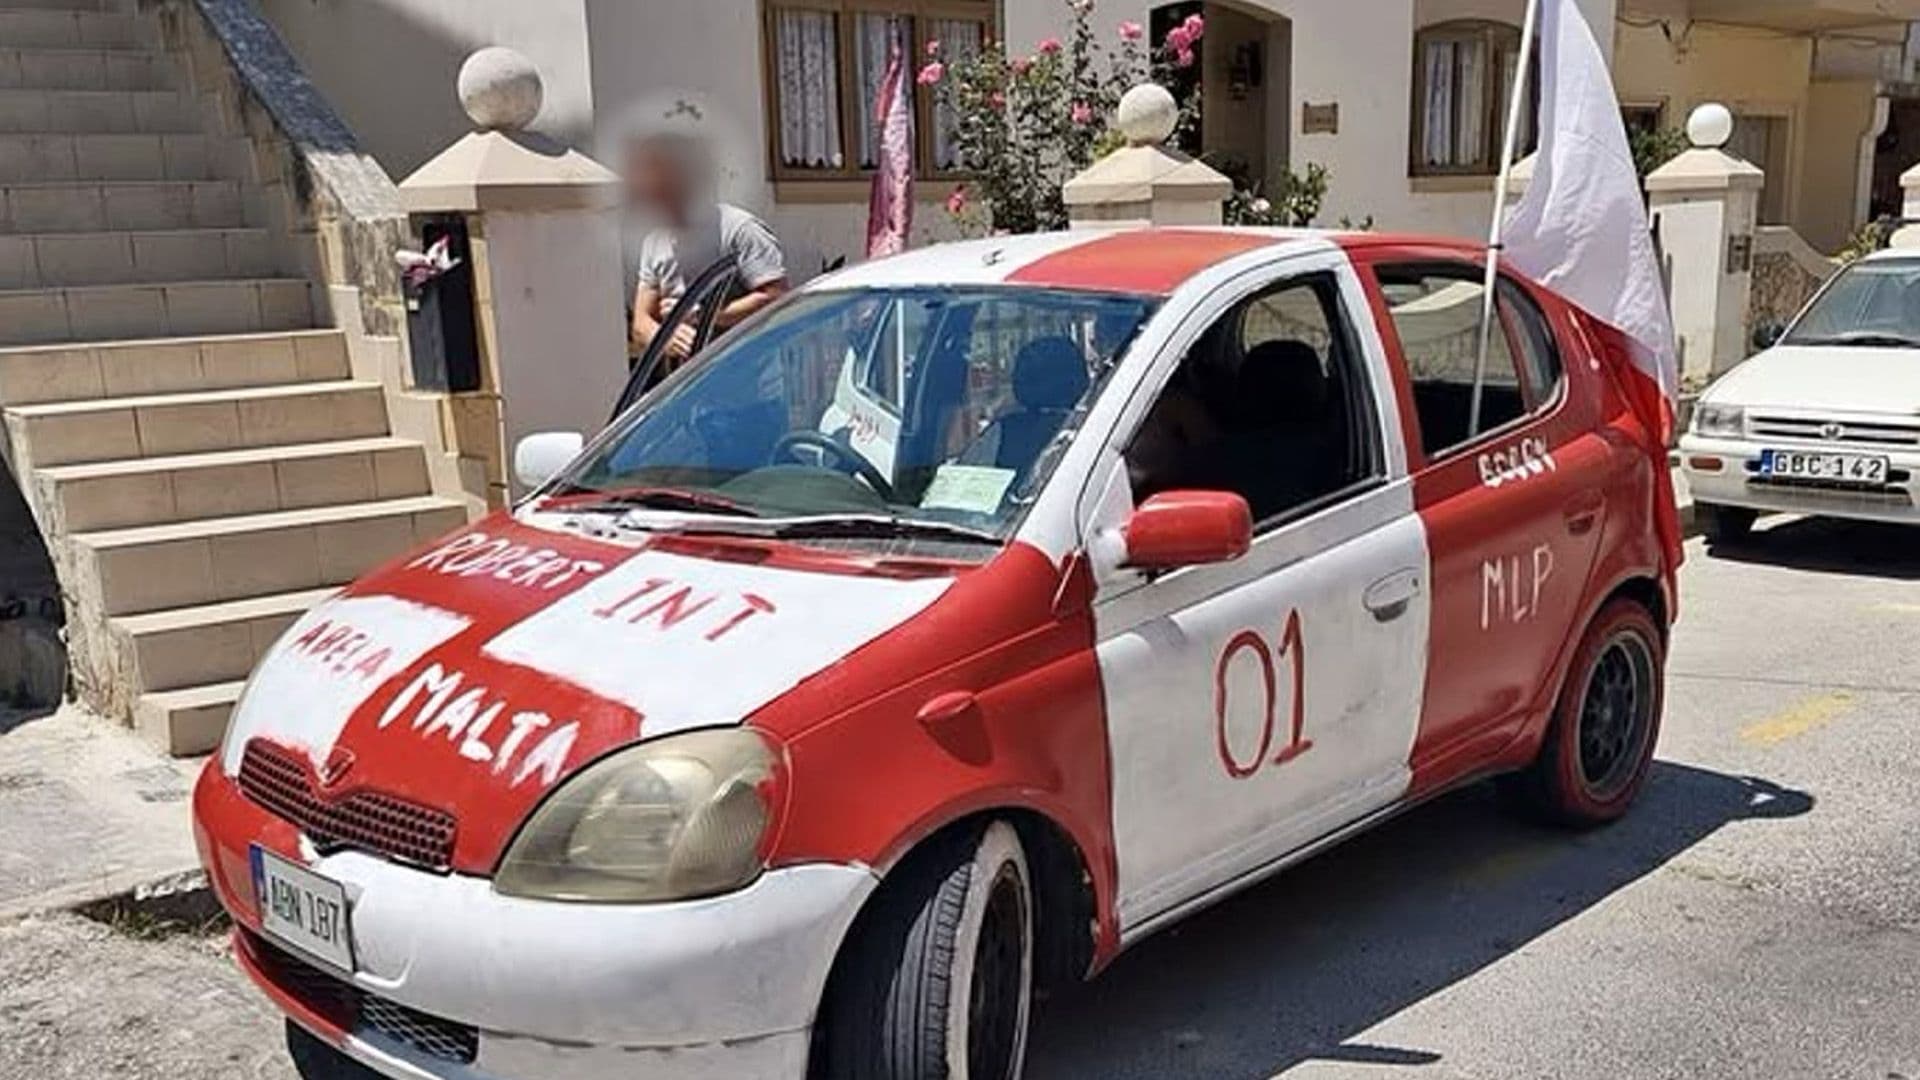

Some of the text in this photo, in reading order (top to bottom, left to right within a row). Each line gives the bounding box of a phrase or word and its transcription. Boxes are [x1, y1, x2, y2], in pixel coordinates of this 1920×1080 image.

[1773, 454, 1883, 480] GBC 142
[404, 531, 604, 590] ROBERT
[1481, 544, 1553, 630] MLP
[592, 577, 777, 641] INT
[292, 619, 393, 681] ABELA
[377, 662, 581, 789] MALTA
[1214, 608, 1313, 780] 01
